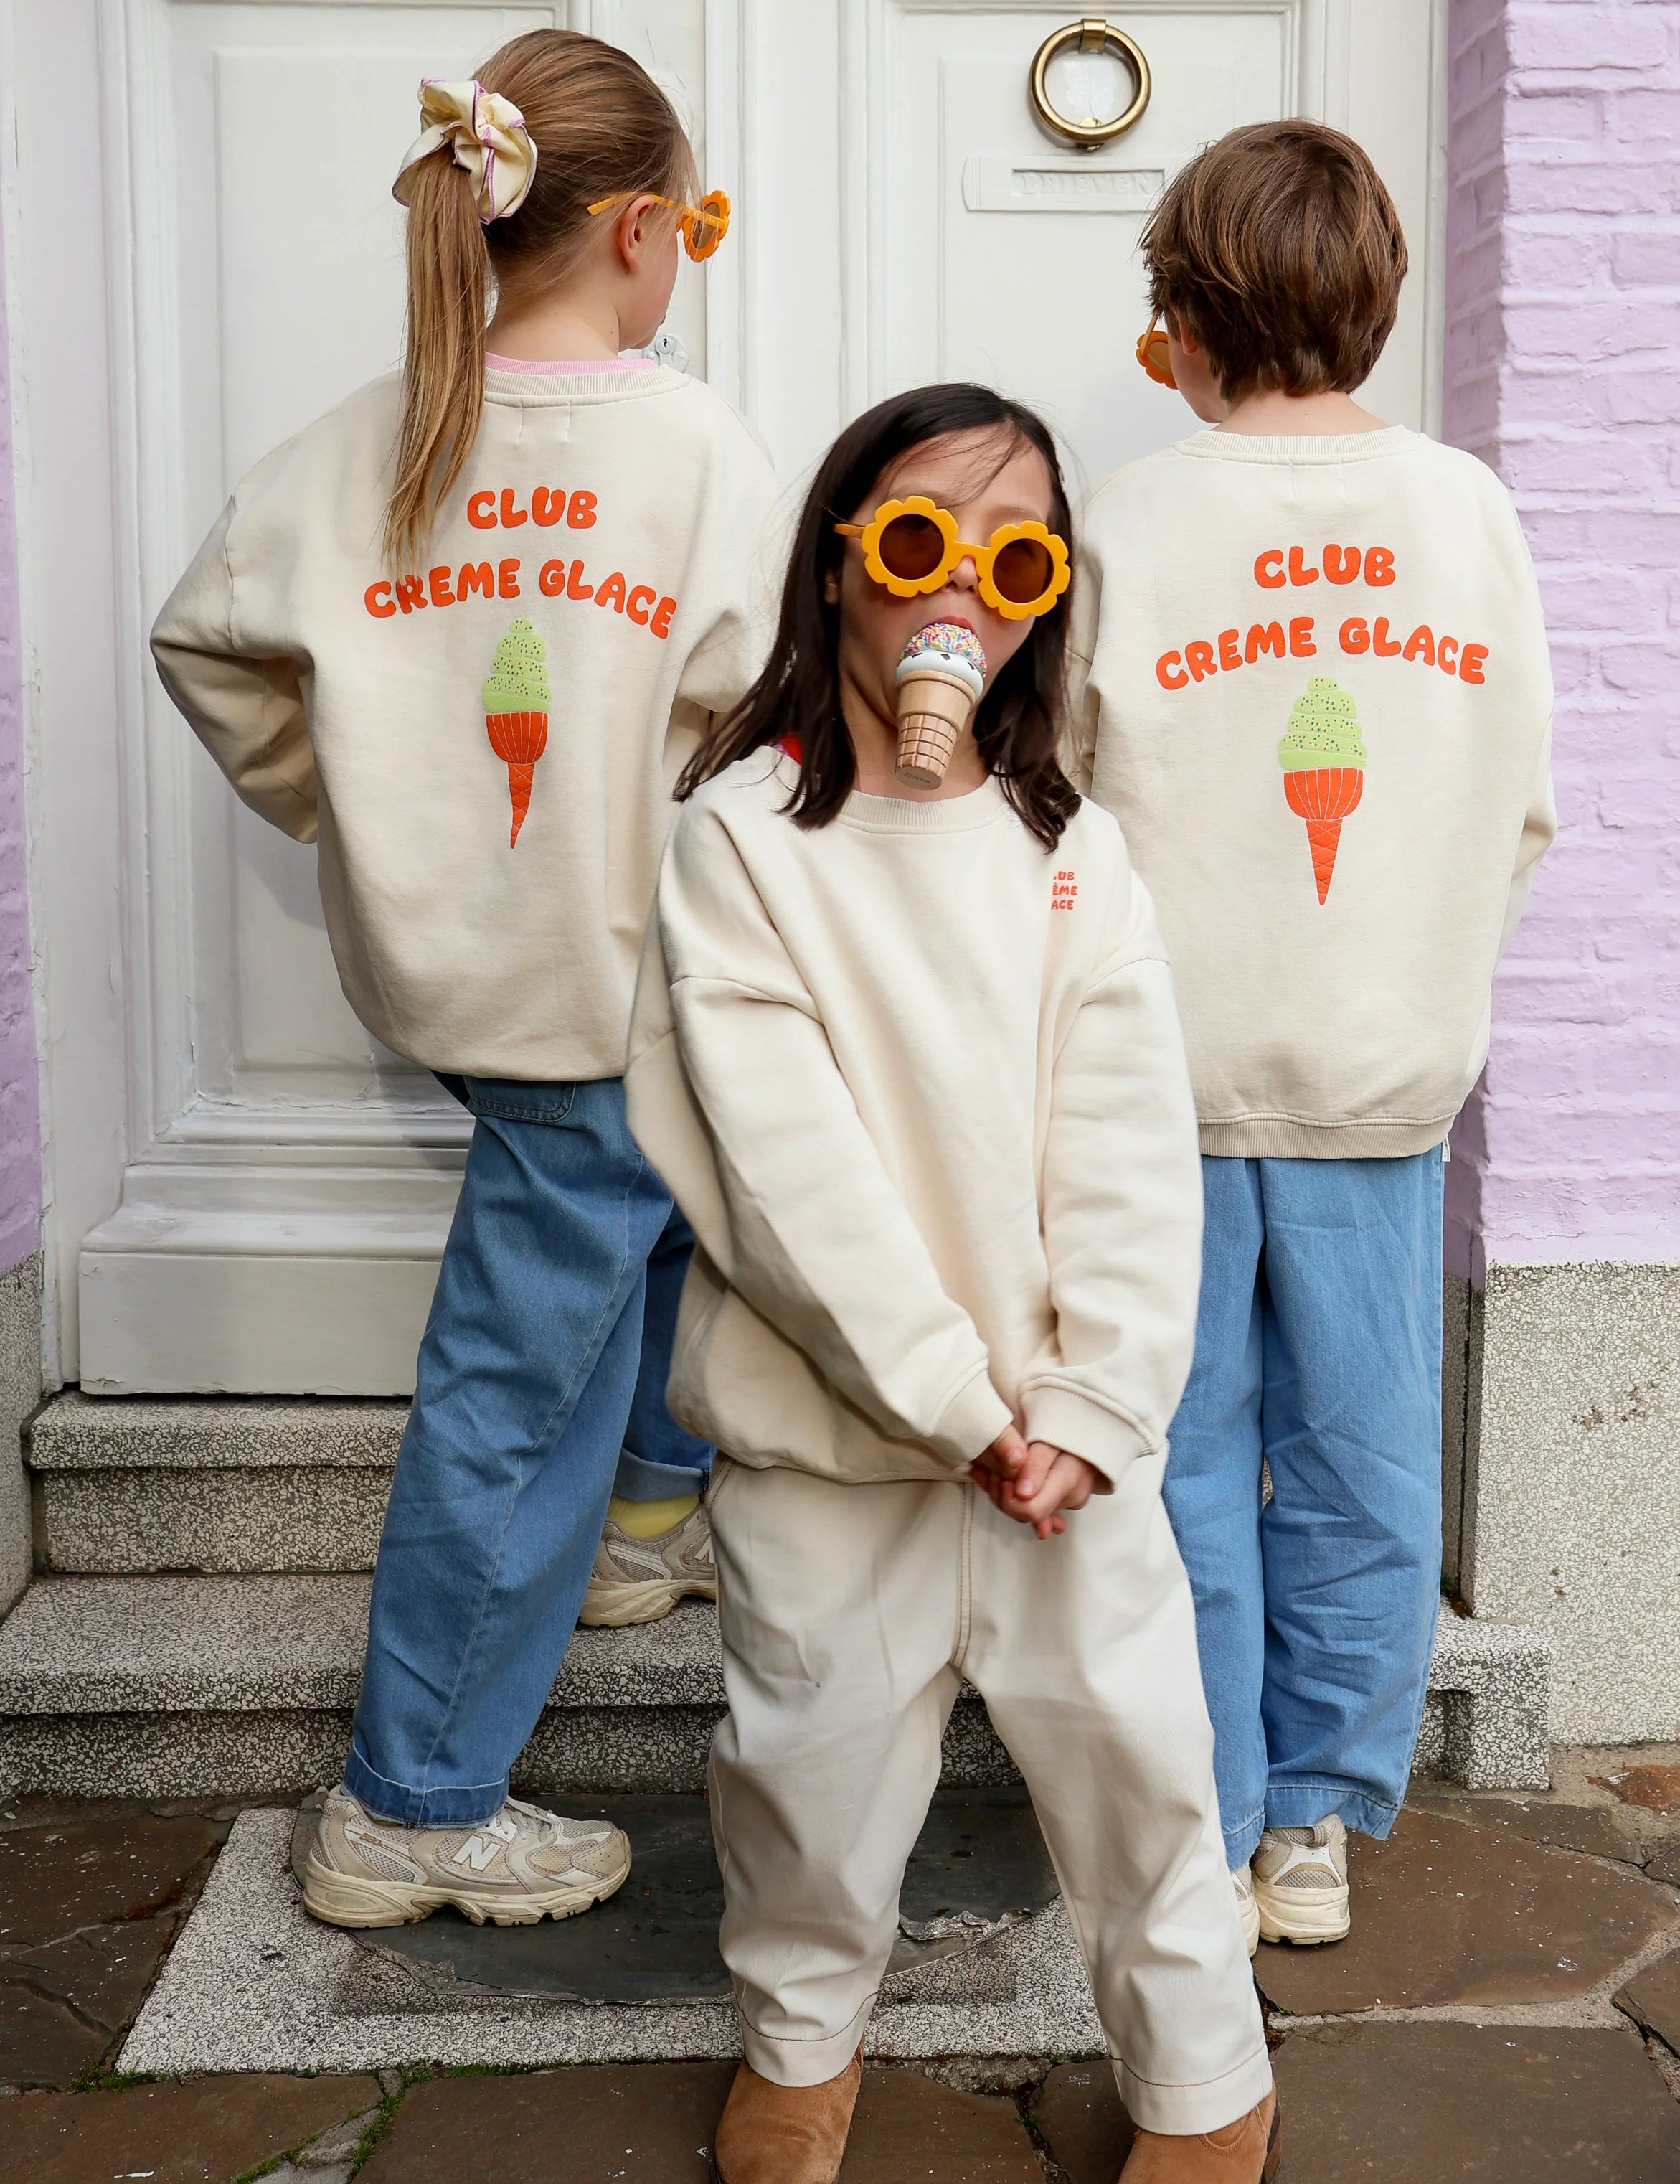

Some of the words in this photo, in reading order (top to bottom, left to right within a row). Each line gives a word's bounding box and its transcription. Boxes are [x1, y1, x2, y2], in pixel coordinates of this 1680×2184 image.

[467, 486, 598, 529] CLUB
[1254, 544, 1396, 588] CLUB
[364, 558, 521, 618] CREME
[539, 559, 676, 639] GLACE
[1156, 616, 1318, 690] CREME
[1339, 616, 1489, 684] GLACE
[1052, 882, 1078, 896] ÈME
[1053, 871, 1075, 881] UB
[1052, 899, 1074, 910] ACE
